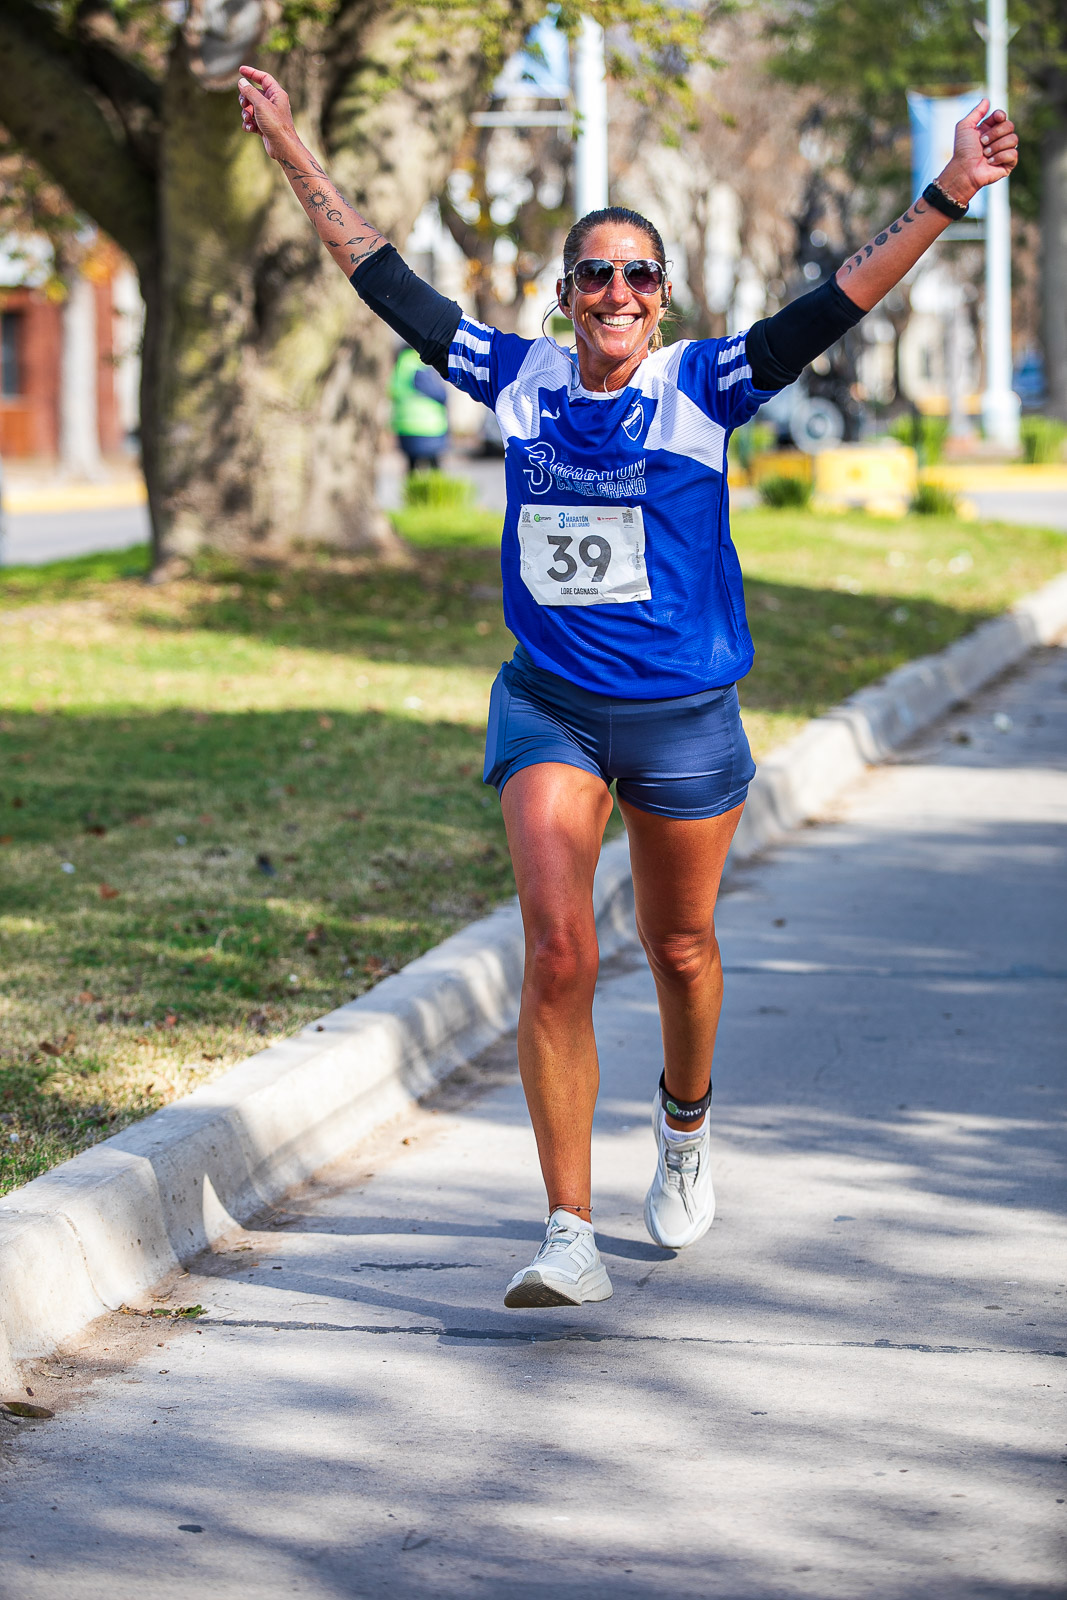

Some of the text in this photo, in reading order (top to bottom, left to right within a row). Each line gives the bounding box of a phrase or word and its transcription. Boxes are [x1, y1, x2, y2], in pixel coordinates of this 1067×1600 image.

[523, 441, 556, 495] 3
[547, 535, 611, 583] 39
[560, 587, 599, 595] LORE CAGNASSI
